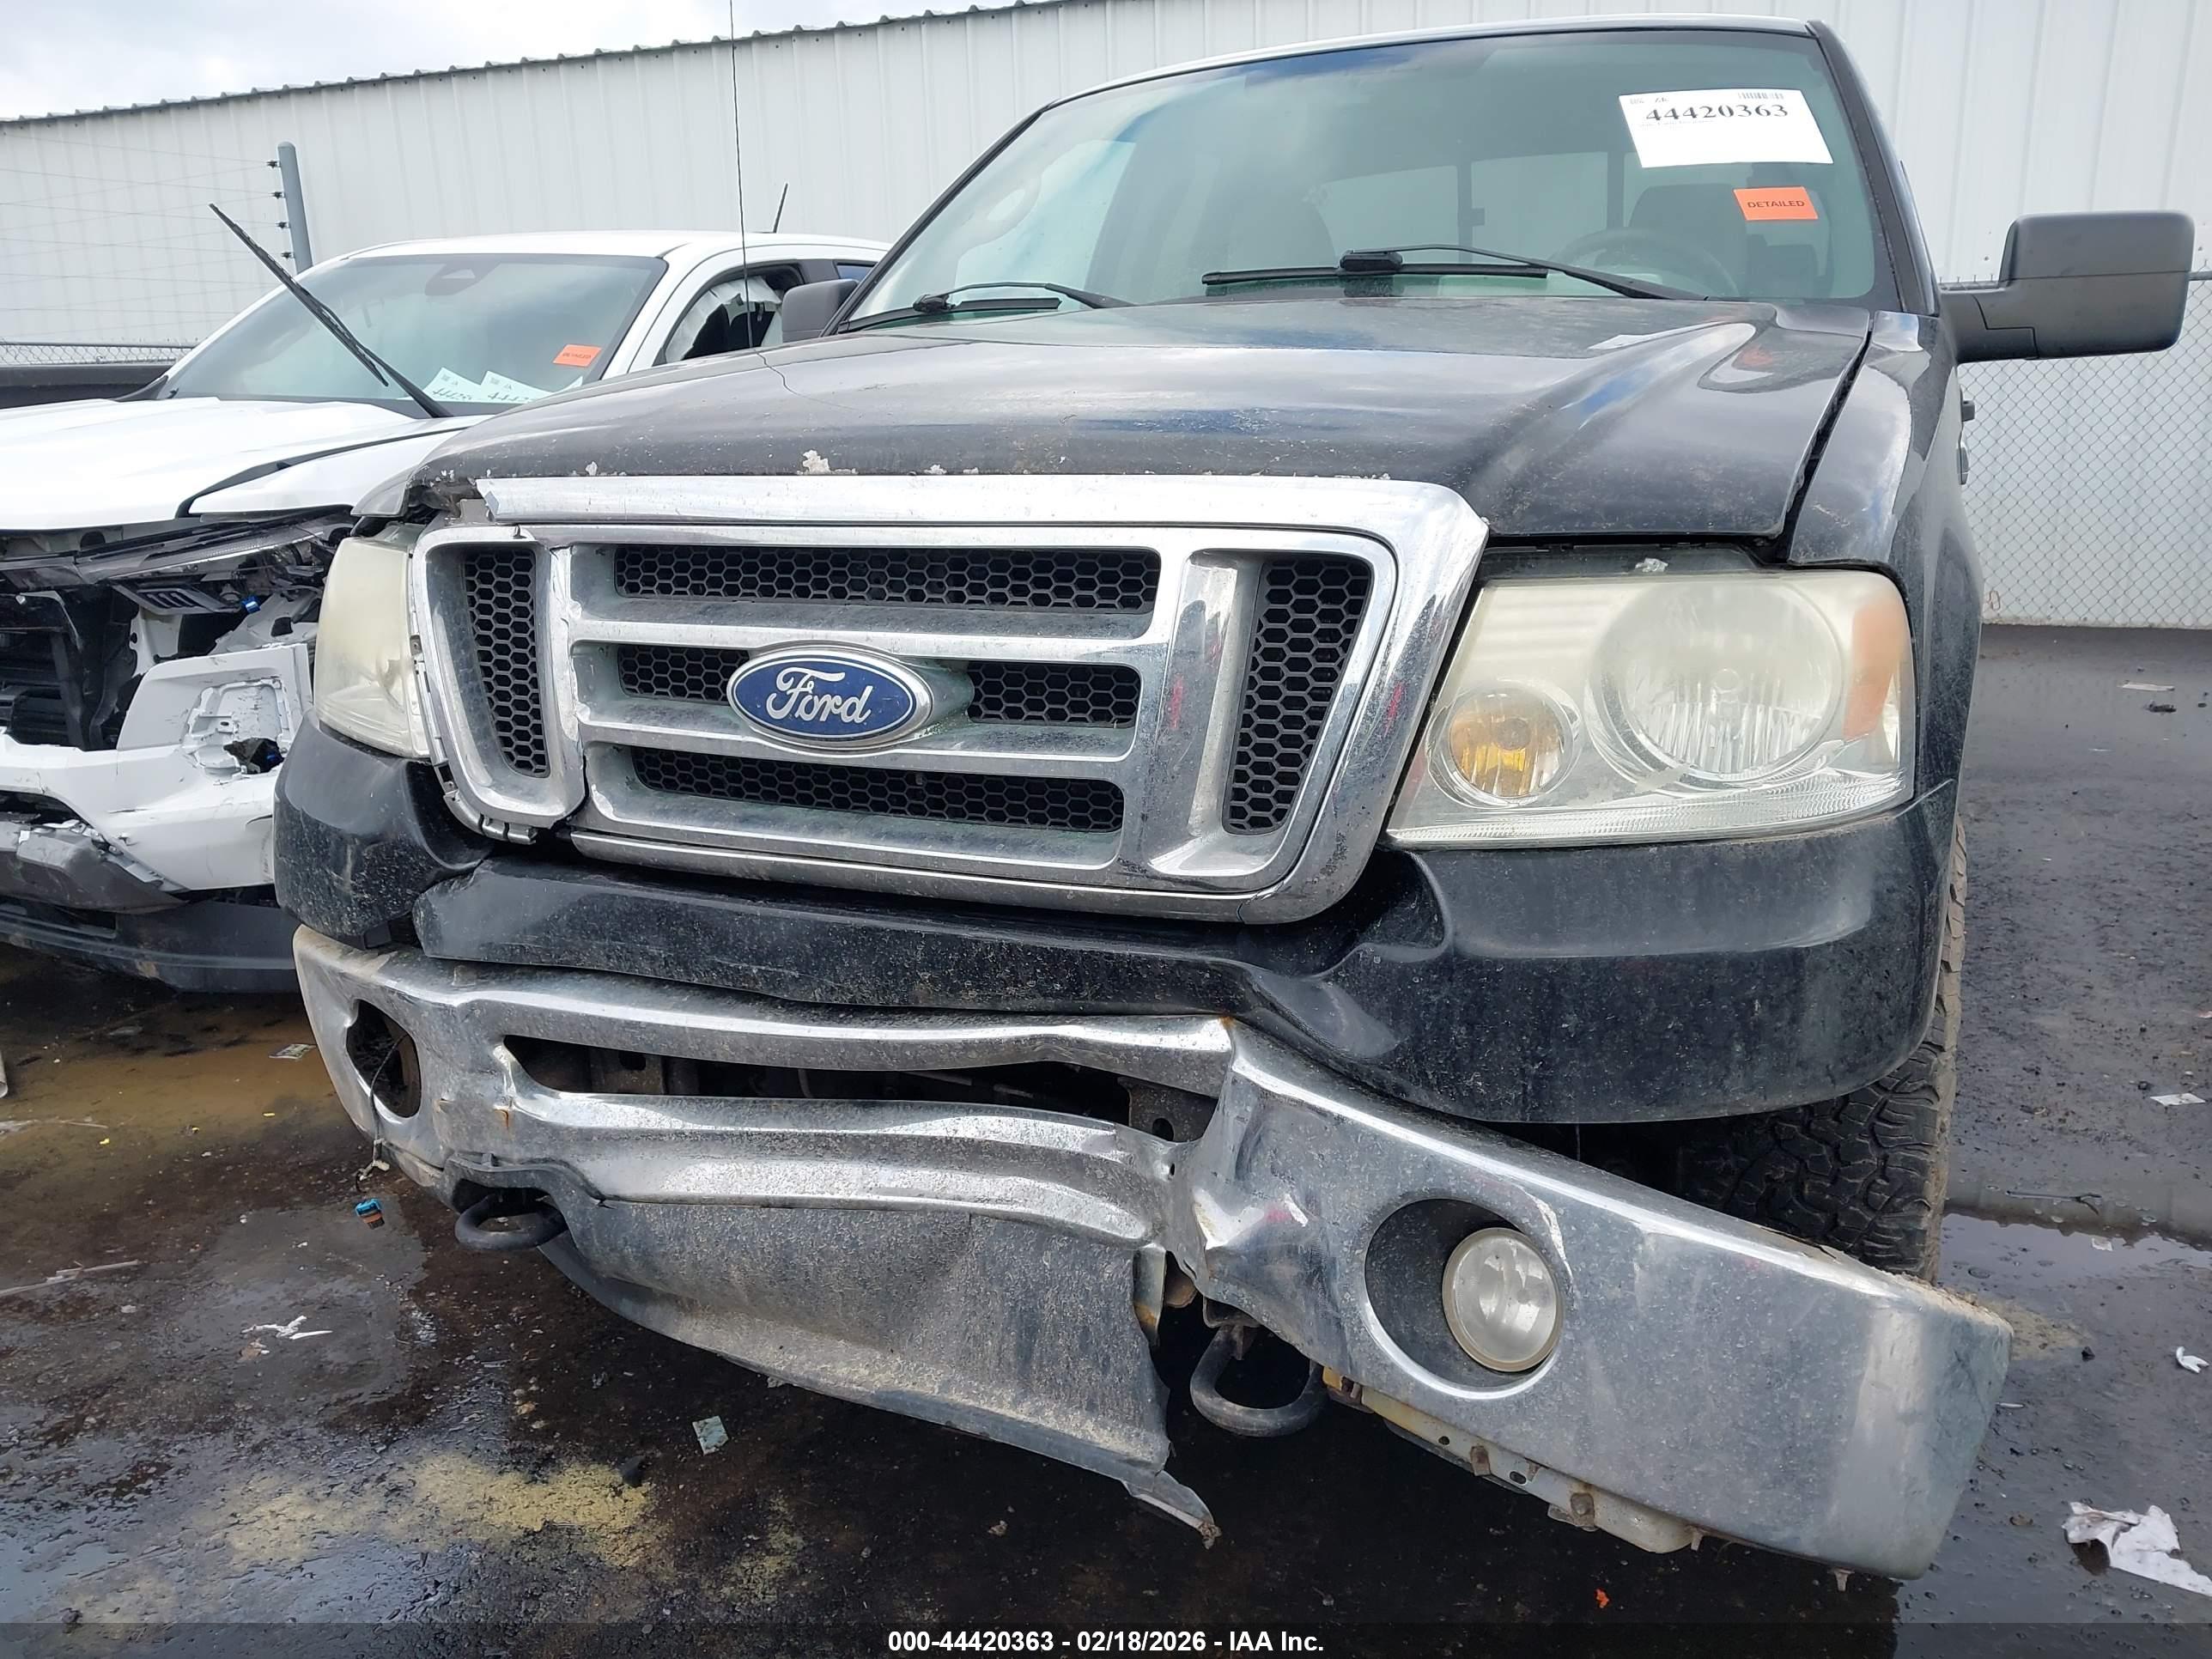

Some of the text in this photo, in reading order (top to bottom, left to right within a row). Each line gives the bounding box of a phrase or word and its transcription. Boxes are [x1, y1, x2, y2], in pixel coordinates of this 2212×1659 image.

[1645, 103, 1789, 121] 44420363
[1747, 199, 1806, 209] DETAILED
[766, 666, 873, 724] Ford
